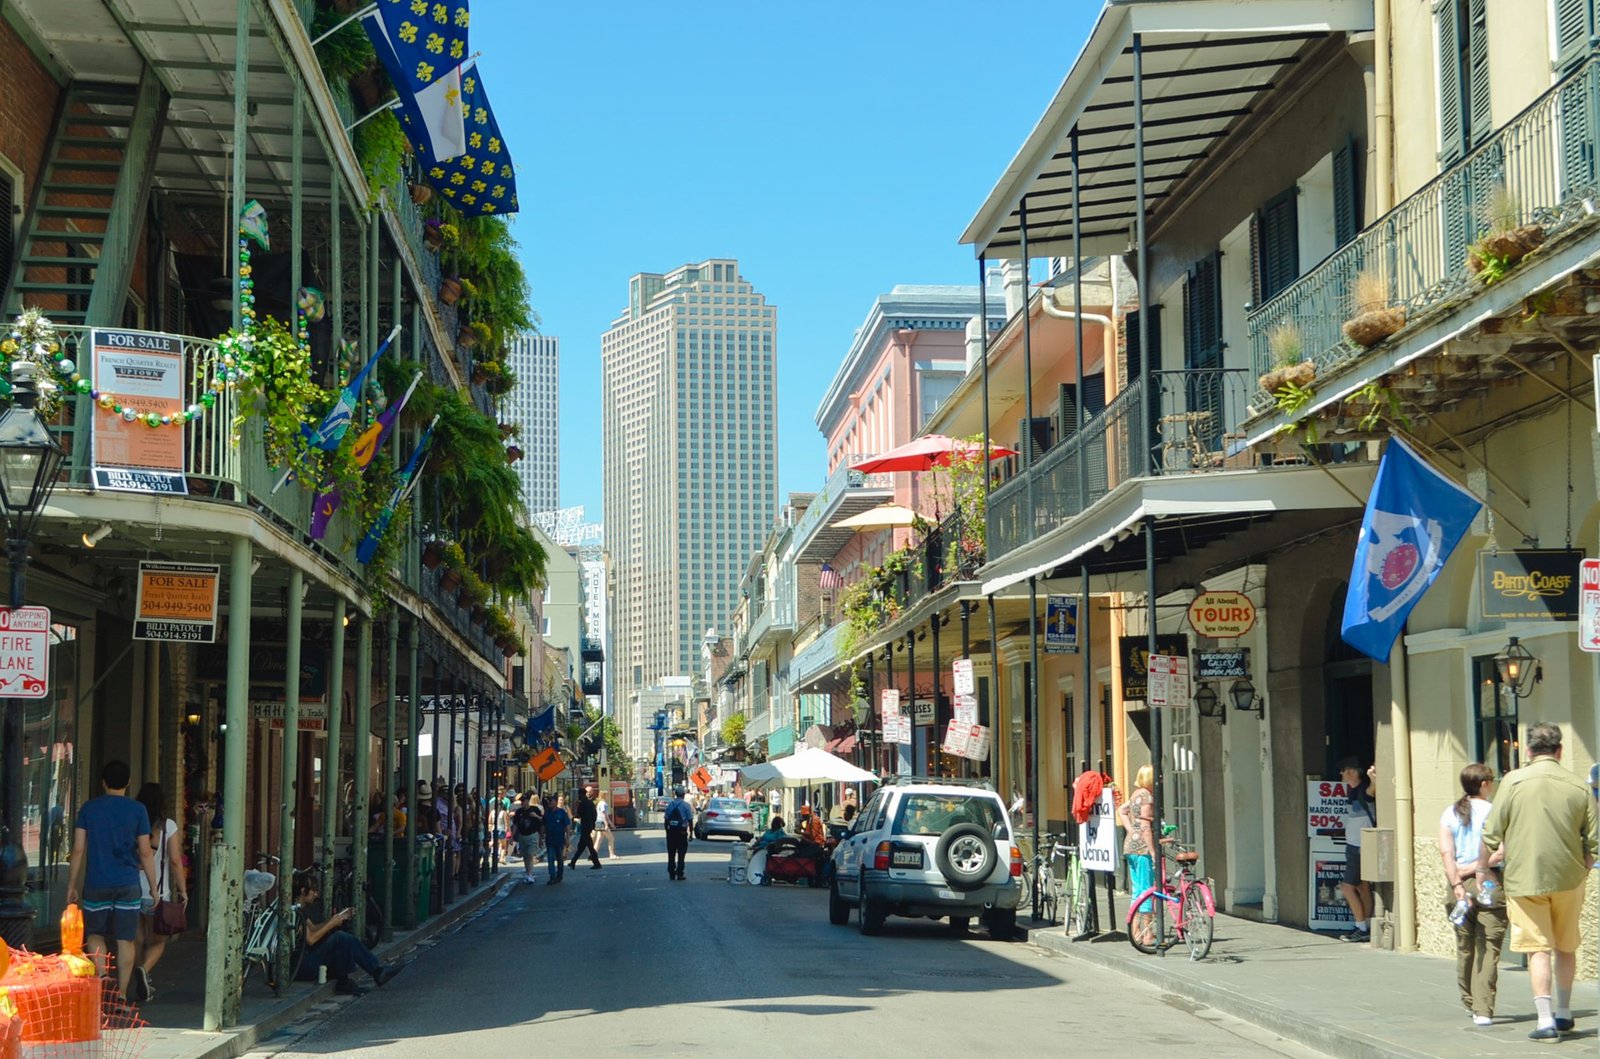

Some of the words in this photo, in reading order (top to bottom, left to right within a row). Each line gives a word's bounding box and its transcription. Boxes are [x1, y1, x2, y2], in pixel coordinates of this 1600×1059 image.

[108, 334, 135, 347] FOR
[138, 336, 171, 350] SALE
[101, 355, 125, 364] FRENCH
[126, 357, 154, 367] QUARTER
[155, 360, 177, 369] REALTY
[120, 368, 159, 377] UPTOWN
[108, 471, 133, 481] BILLY
[134, 474, 172, 484] PATOUT
[109, 480, 173, 491] 504.914.5191
[149, 576, 174, 587] FOR
[177, 577, 209, 588] SALE
[592, 572, 600, 608] HOTEL
[143, 601, 212, 613] 504-949-5400
[11, 611, 46, 620] STOPPING
[1194, 608, 1250, 622] TOURS
[13, 621, 43, 629] ANYTIME
[146, 623, 169, 631] BILLY
[170, 625, 204, 633] PATOUT
[145, 631, 202, 640] 504.914.5191
[2, 637, 32, 651] FIRE
[1309, 806, 1332, 814] MARDI
[1310, 815, 1344, 828] 50%
[1088, 820, 1098, 840] by
[1082, 841, 1110, 862] Jenna
